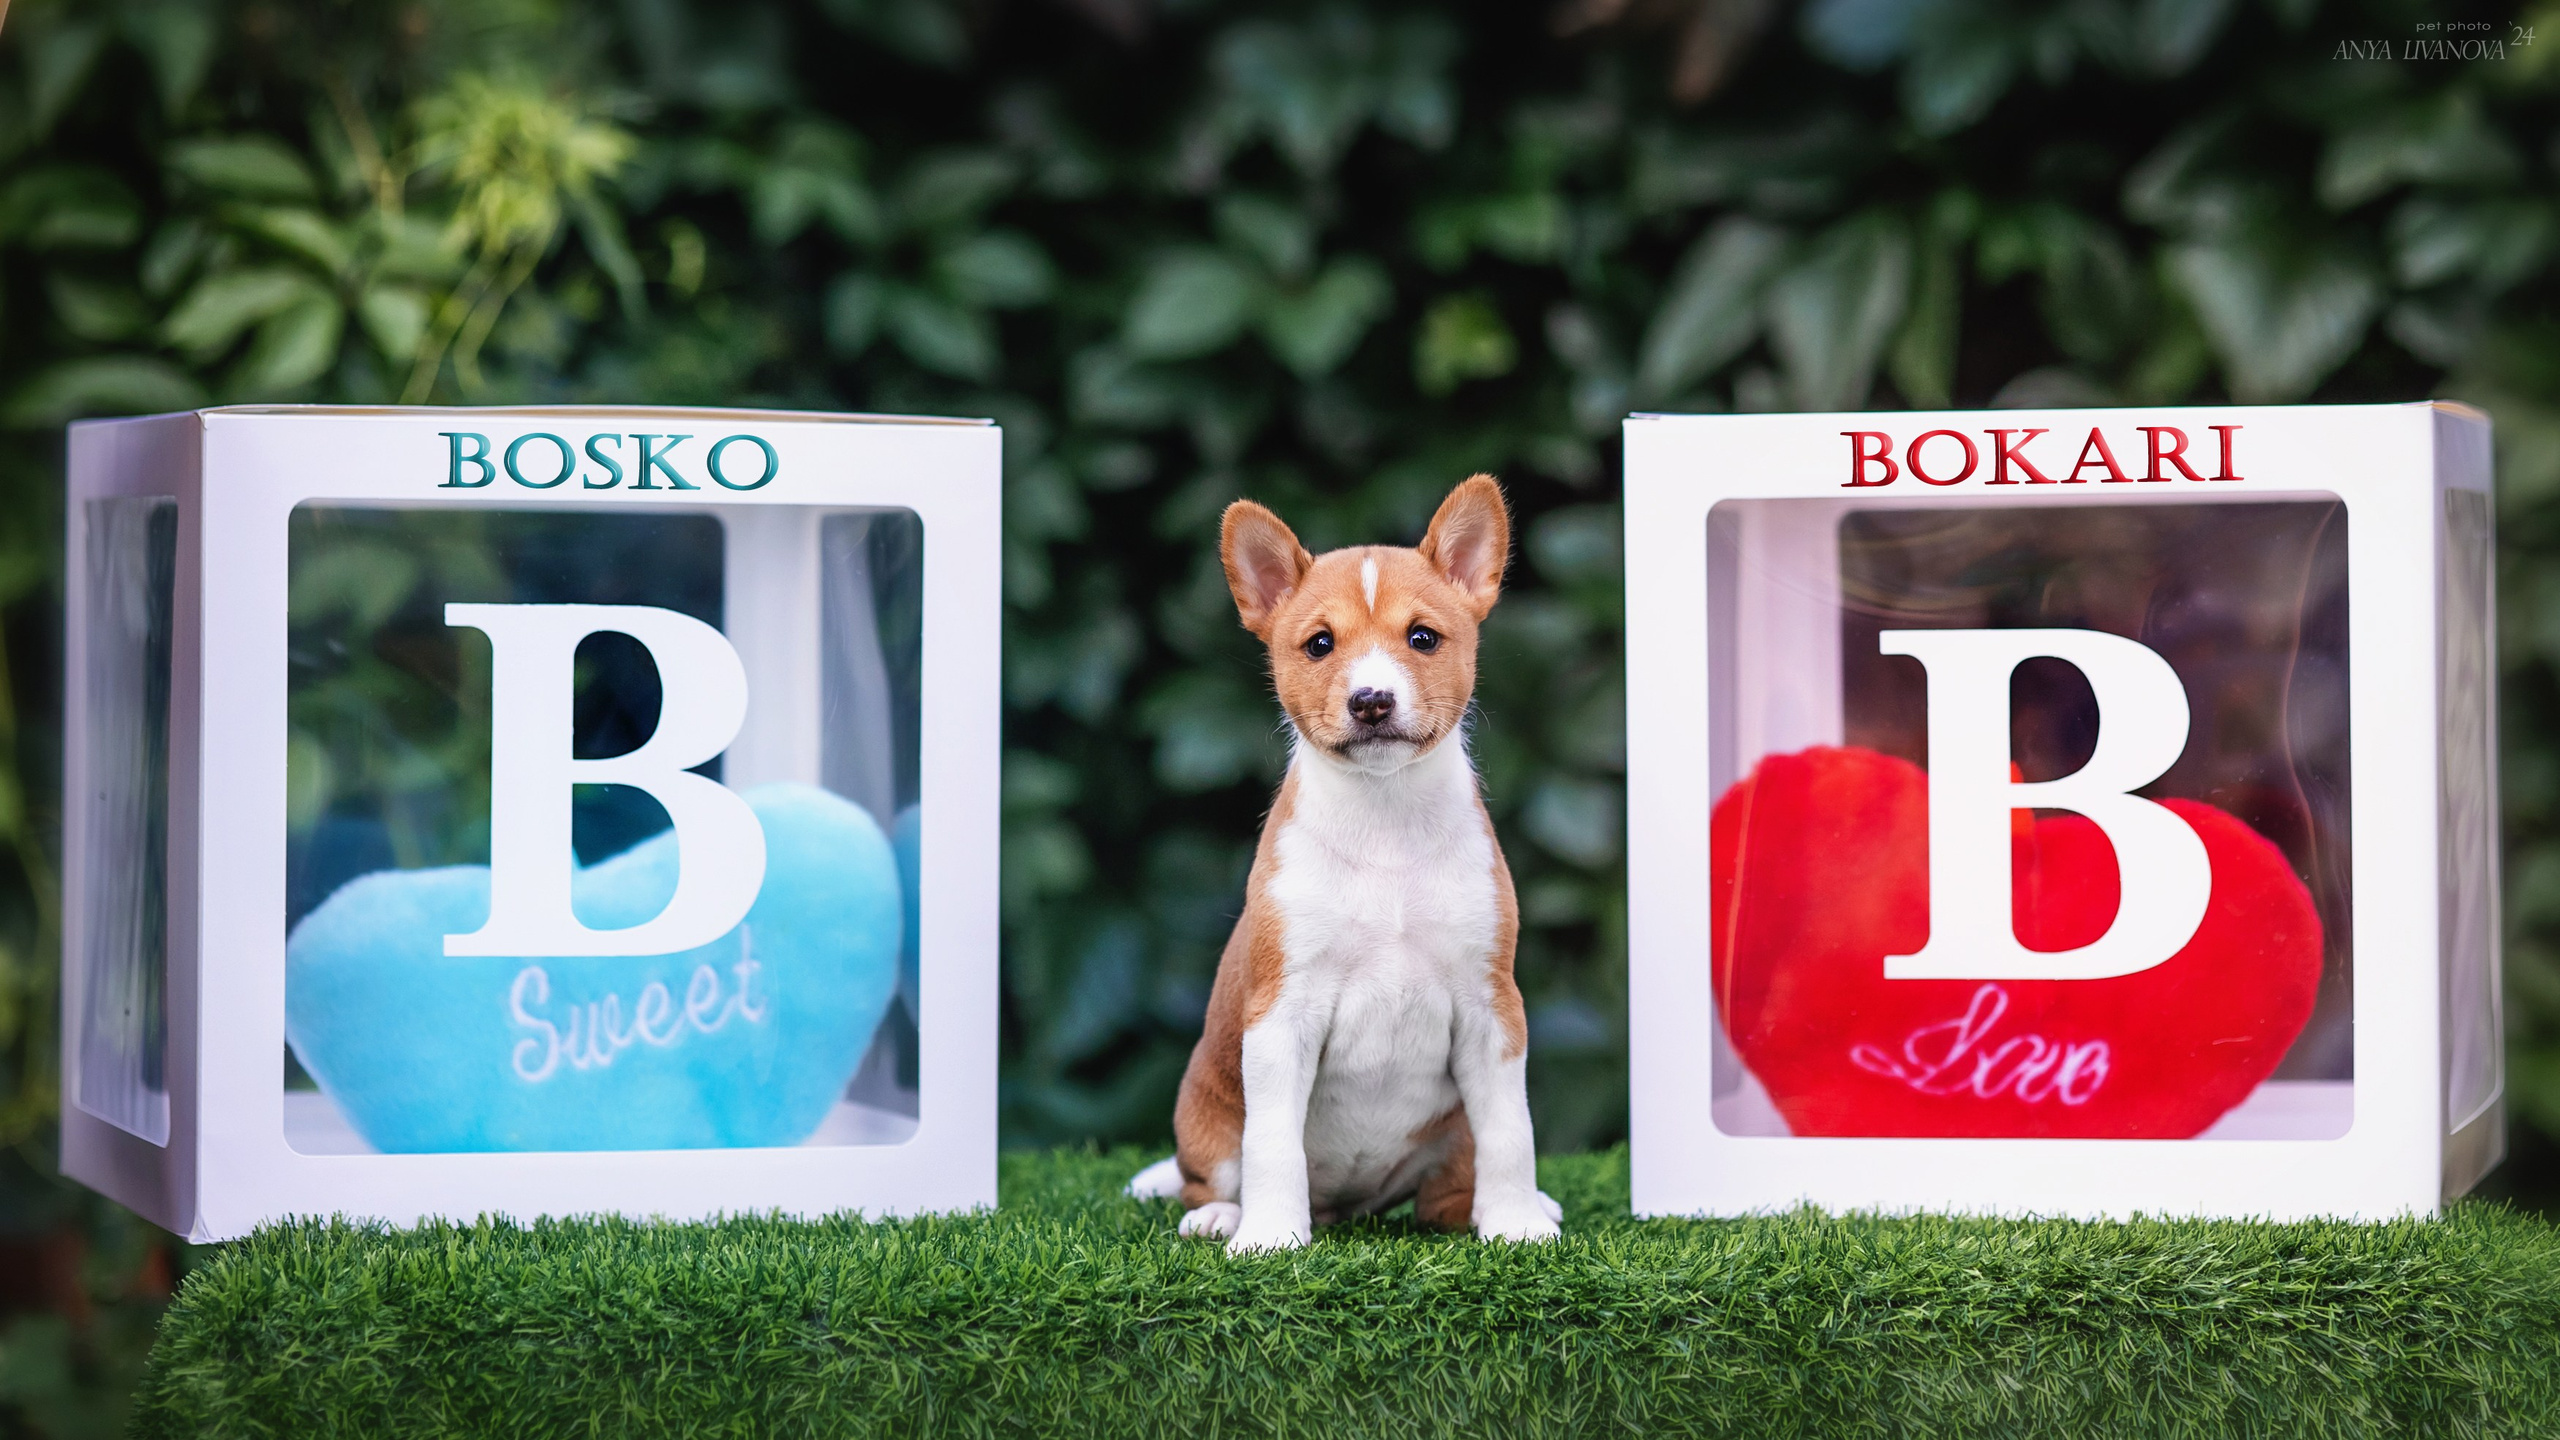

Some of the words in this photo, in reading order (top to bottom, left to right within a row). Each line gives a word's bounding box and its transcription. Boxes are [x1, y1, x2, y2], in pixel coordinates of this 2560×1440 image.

[444, 603, 767, 957] B
[1879, 628, 2212, 980] B
[509, 923, 767, 1084] Sweet
[1850, 984, 2111, 1106] Love
